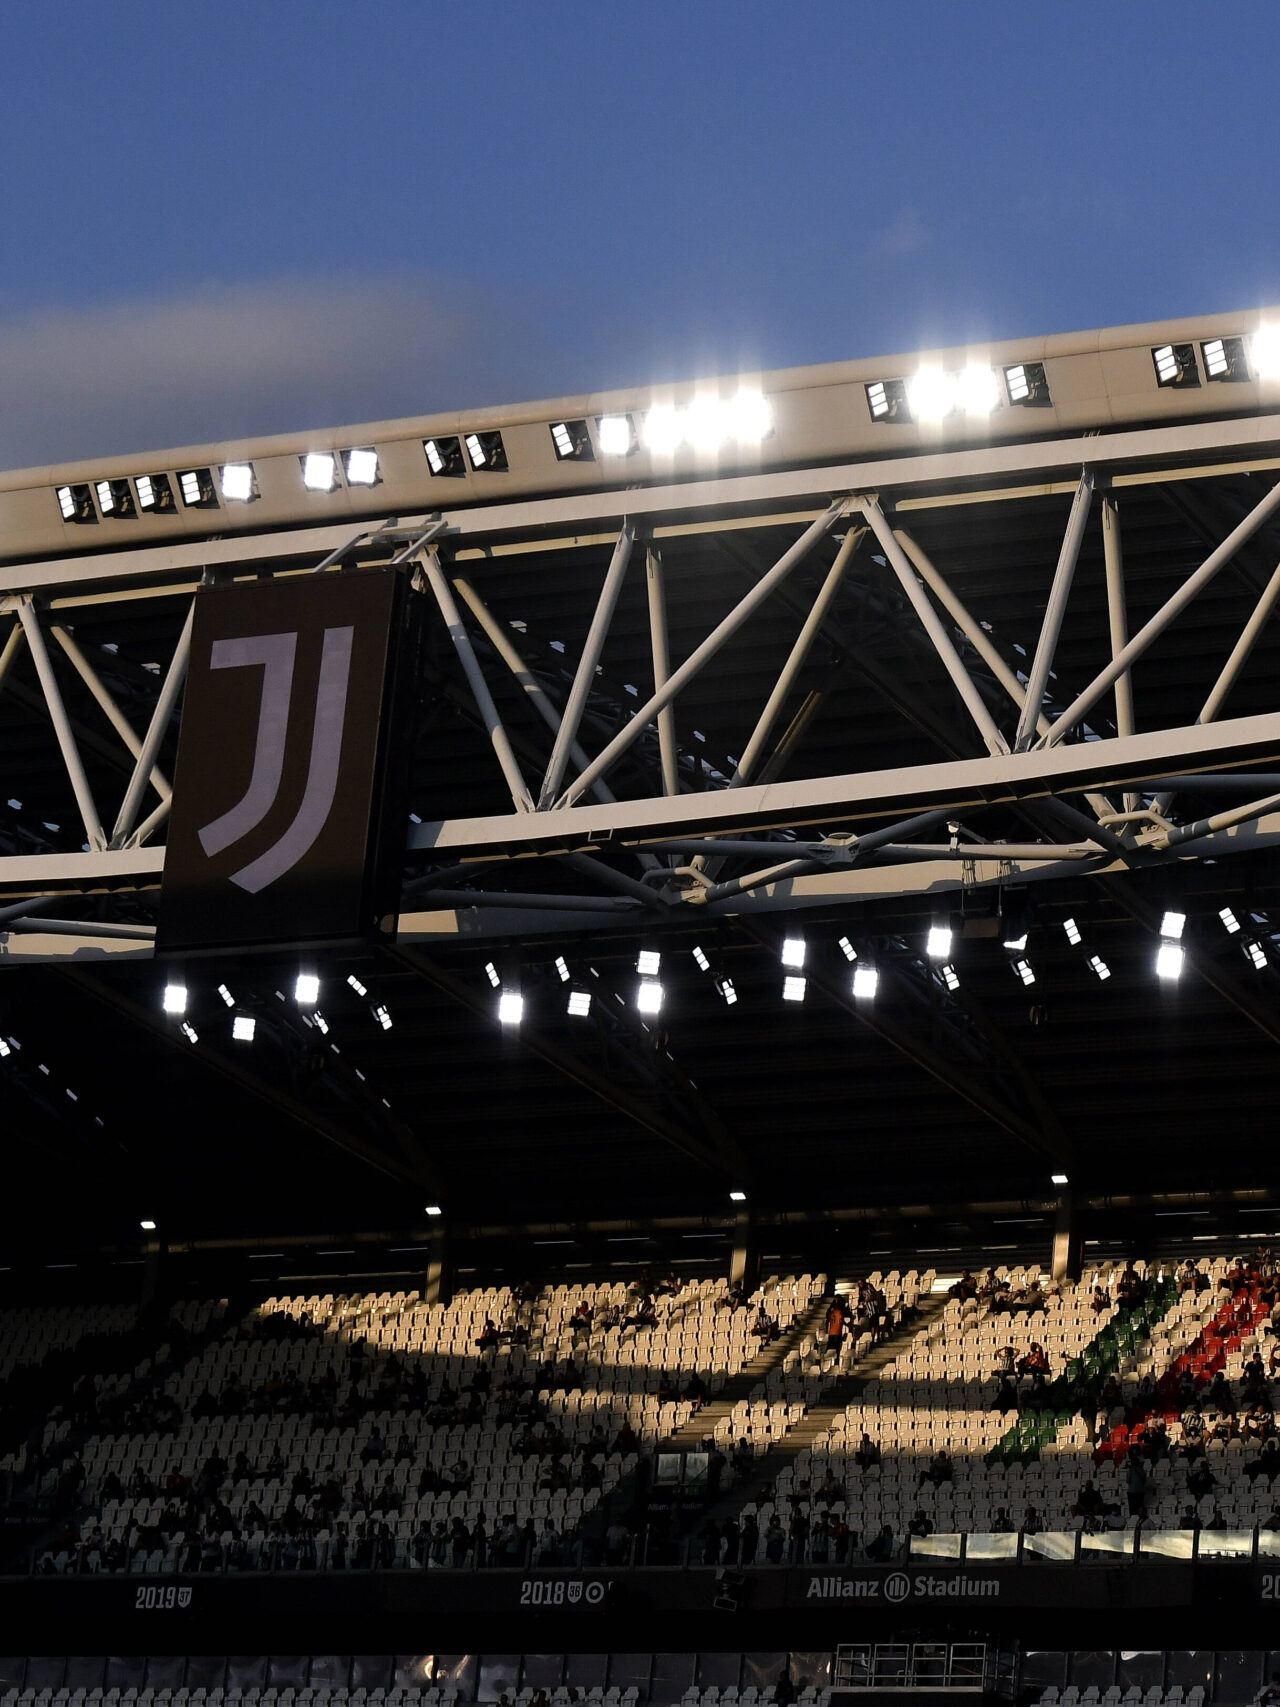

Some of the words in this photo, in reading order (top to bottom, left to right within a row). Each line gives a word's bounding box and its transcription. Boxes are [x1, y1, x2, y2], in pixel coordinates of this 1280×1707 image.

[135, 1586, 177, 1609] 2019
[520, 1580, 566, 1605] 2018
[806, 1577, 880, 1598] Allianz
[914, 1575, 1000, 1597] Stadium
